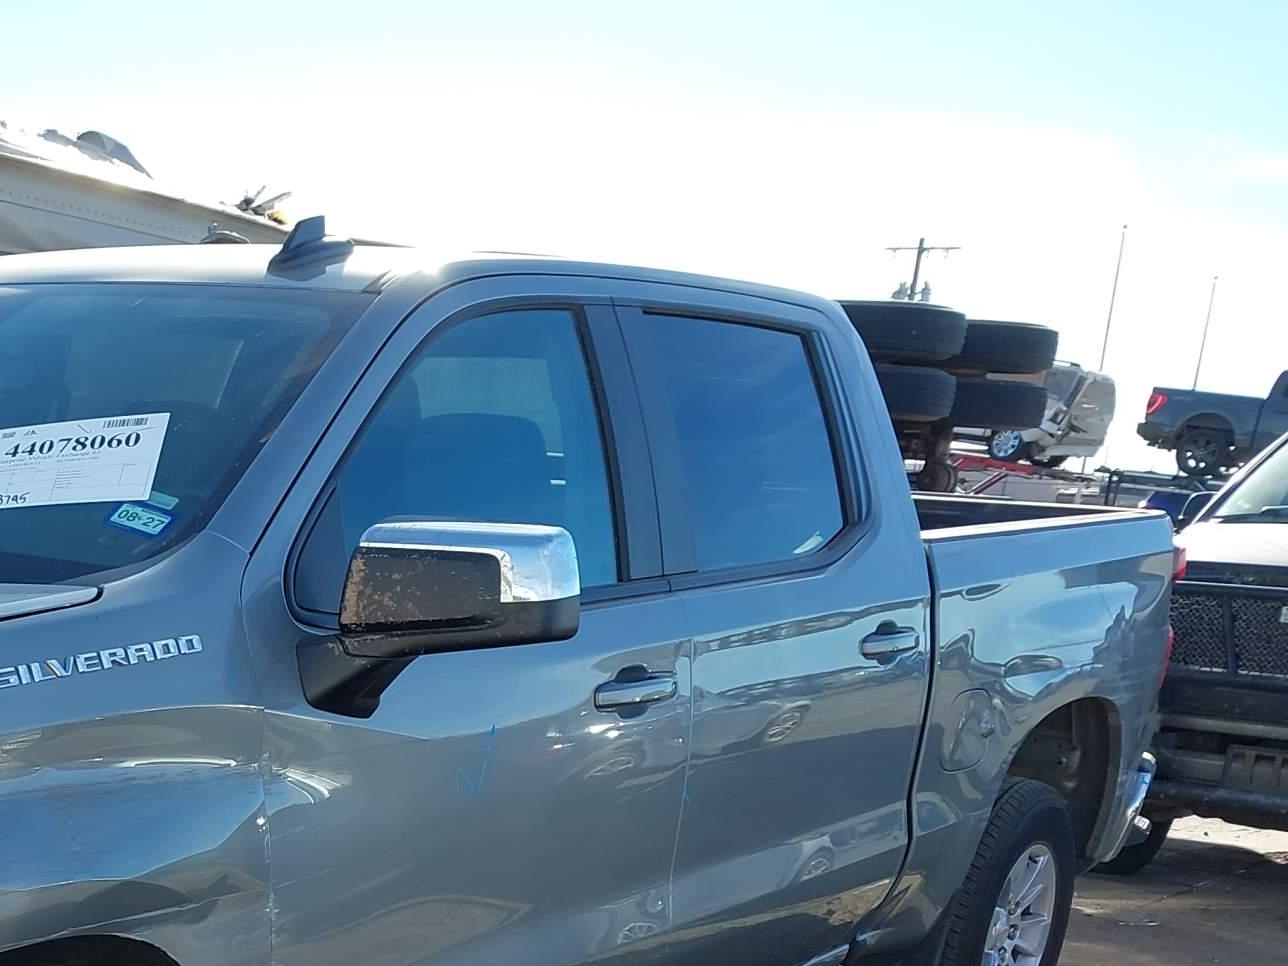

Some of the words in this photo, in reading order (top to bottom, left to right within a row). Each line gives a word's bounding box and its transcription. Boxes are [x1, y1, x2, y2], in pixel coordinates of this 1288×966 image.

[4, 431, 142, 458] 44078060
[117, 509, 139, 522] 08
[141, 516, 166, 529] 27
